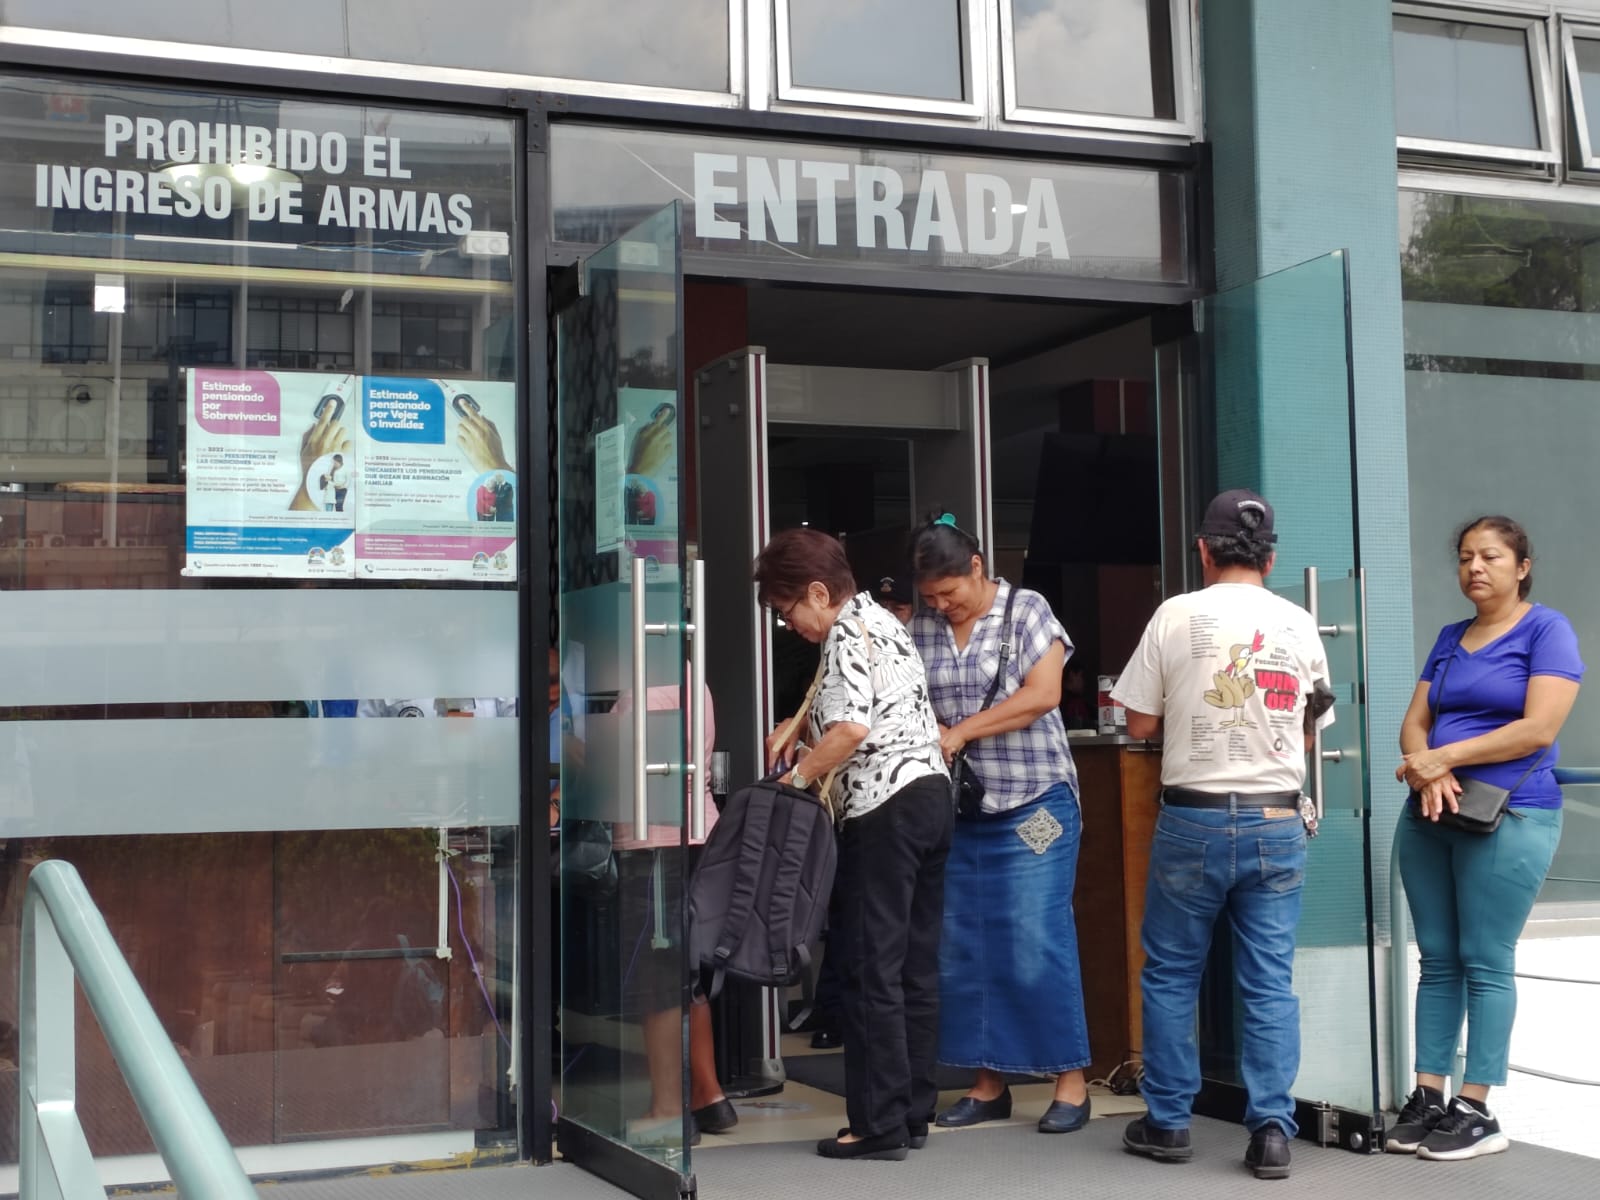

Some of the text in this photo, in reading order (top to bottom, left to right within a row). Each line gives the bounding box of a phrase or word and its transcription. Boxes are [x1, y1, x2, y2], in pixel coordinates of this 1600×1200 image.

[105, 114, 412, 179] PROHIBIDO EL
[36, 164, 473, 236] INGRESO DE ARMAS
[693, 152, 1070, 260] ENTRADA
[202, 381, 252, 392] Estimado
[202, 392, 265, 402] pensionado
[369, 389, 419, 400] Estimado
[202, 402, 221, 412] por
[369, 400, 431, 410] pensionado
[202, 410, 278, 422] Sobrevivencia
[369, 410, 419, 421] por Vejez
[369, 420, 424, 430] o Invalidez
[1264, 689, 1298, 713] OFF
